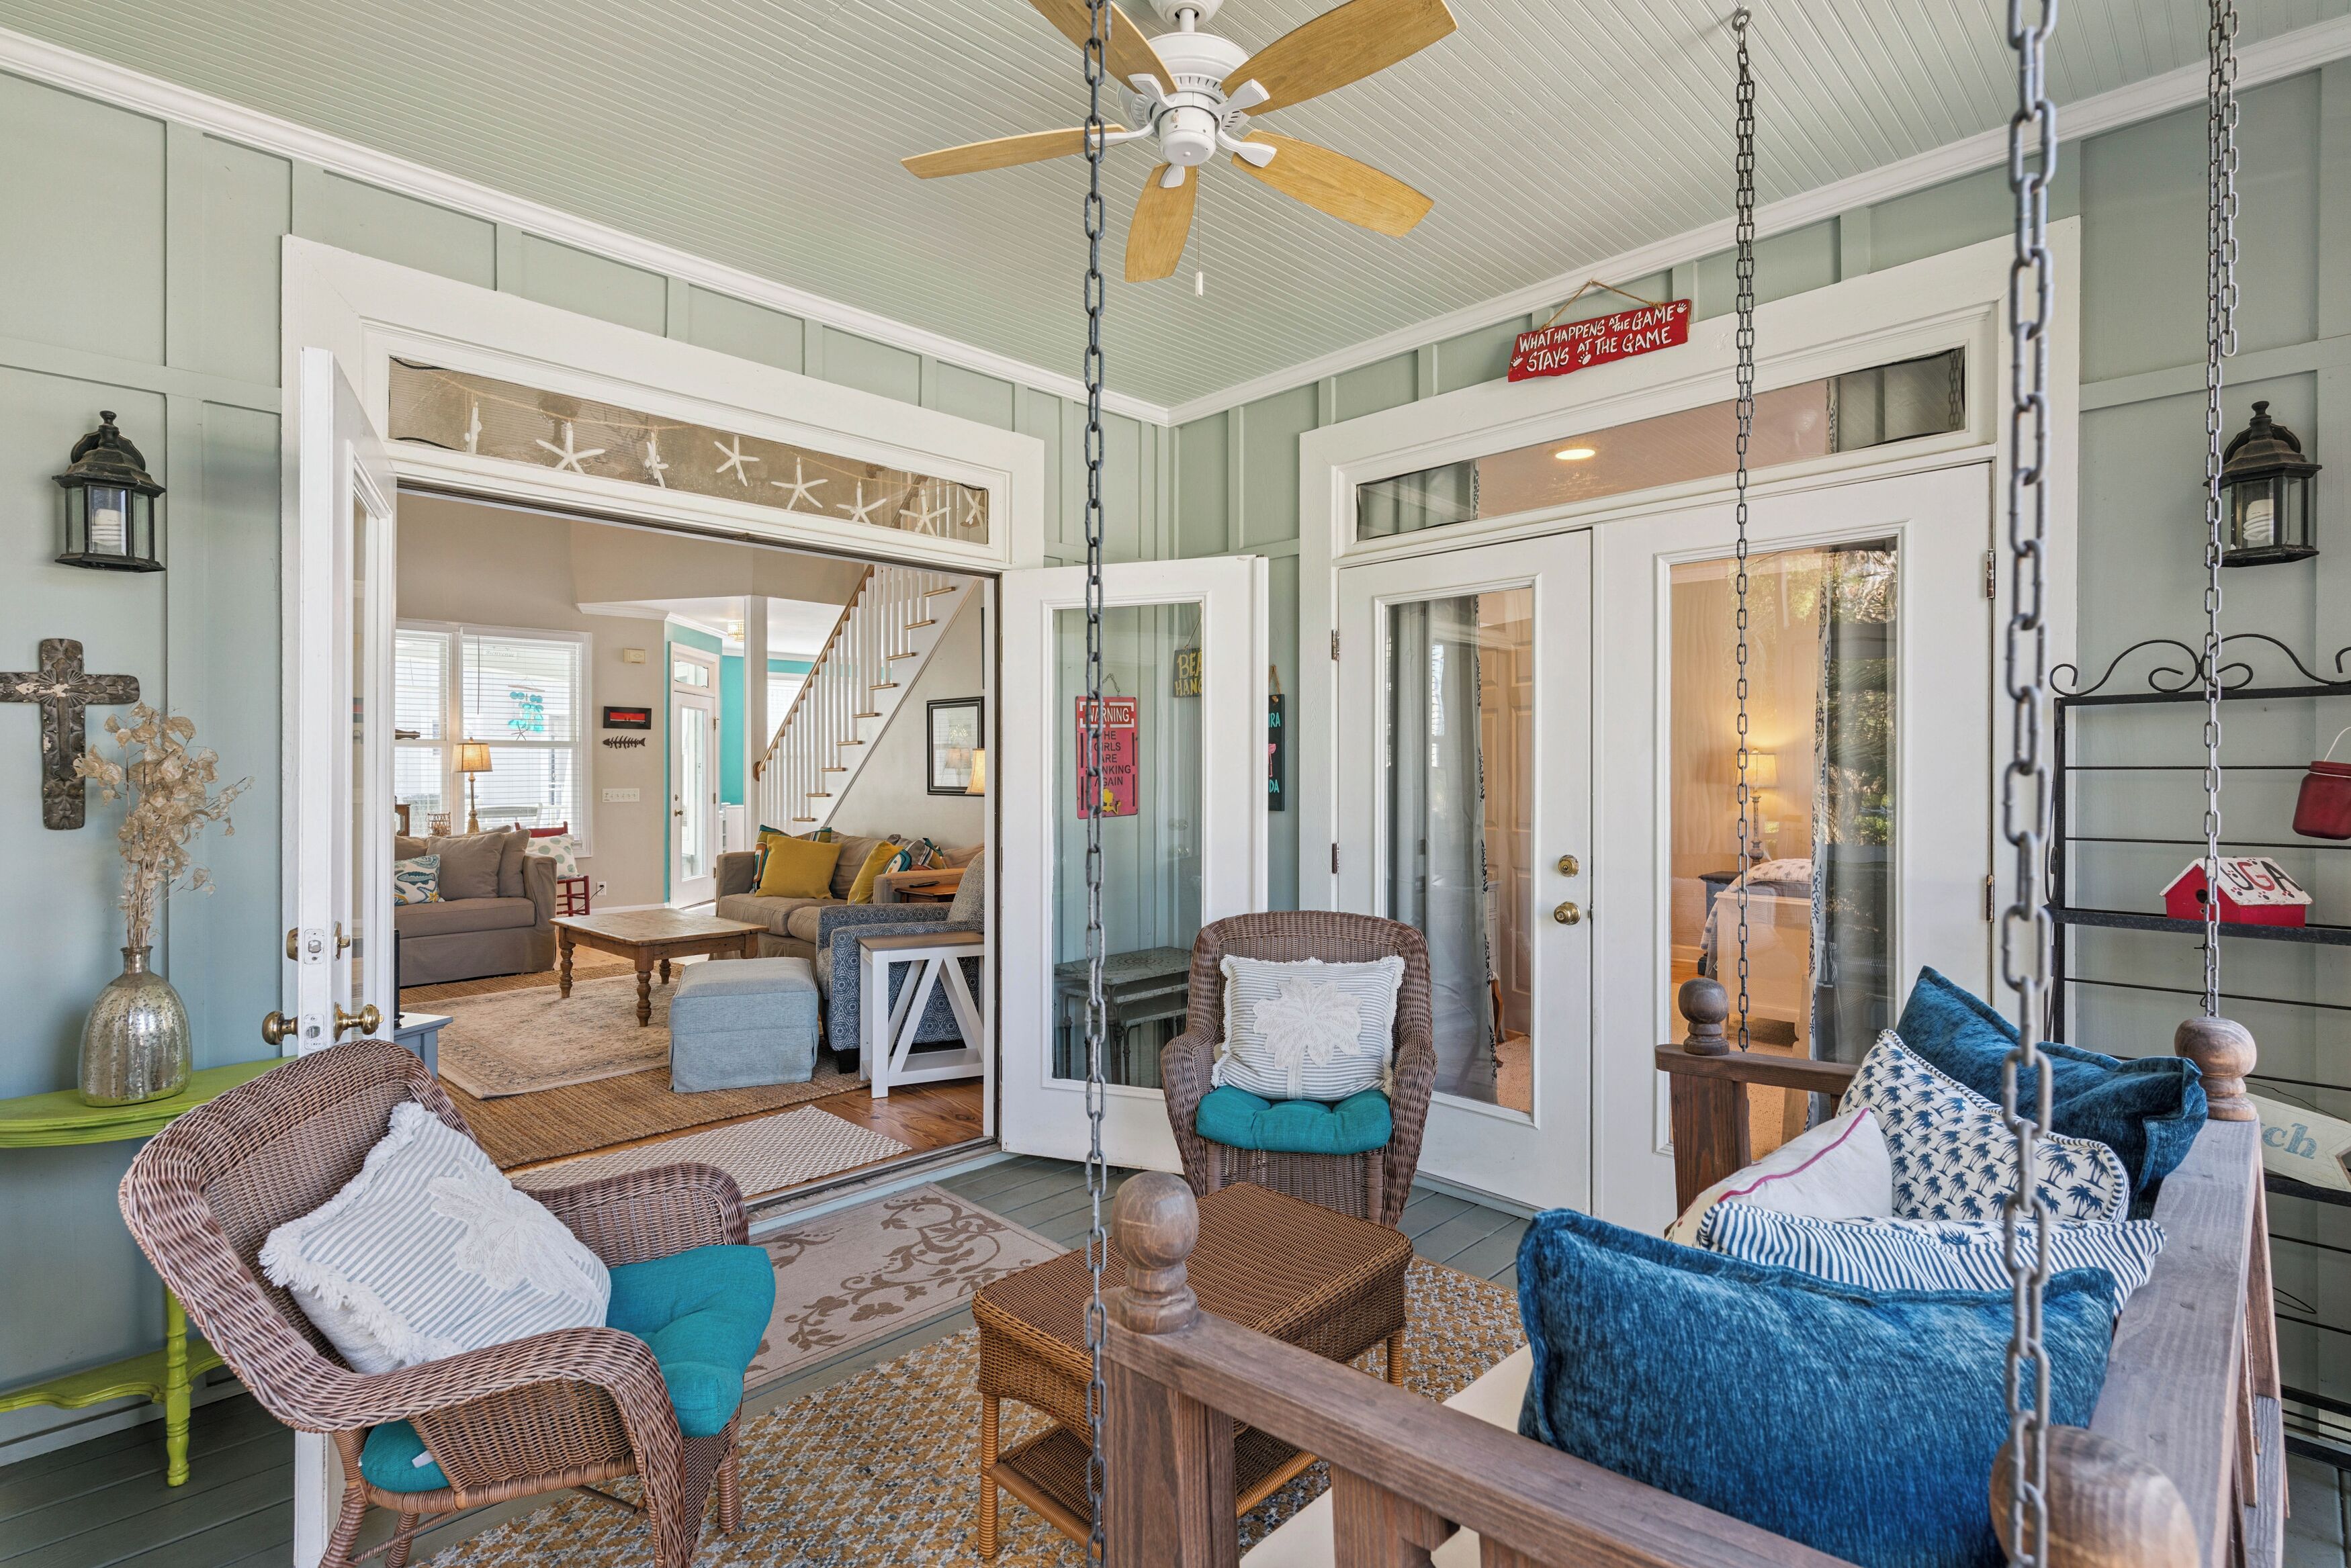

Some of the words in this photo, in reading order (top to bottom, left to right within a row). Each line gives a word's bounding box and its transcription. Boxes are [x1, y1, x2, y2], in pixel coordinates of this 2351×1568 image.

[1608, 314, 1621, 326] AT
[1612, 318, 1630, 332] THE
[1632, 304, 1675, 330] GAME
[1519, 328, 1555, 353] WHAT
[1553, 319, 1605, 344] HAPPENS
[1526, 347, 1569, 372] STAYS
[1577, 338, 1593, 354] AT
[1595, 336, 1618, 355] THE
[1622, 326, 1672, 353] GAME
[1268, 712, 1281, 728] RA
[1102, 731, 1116, 740] HE
[2220, 860, 2303, 891] UGA
[2260, 1122, 2317, 1159] ch
